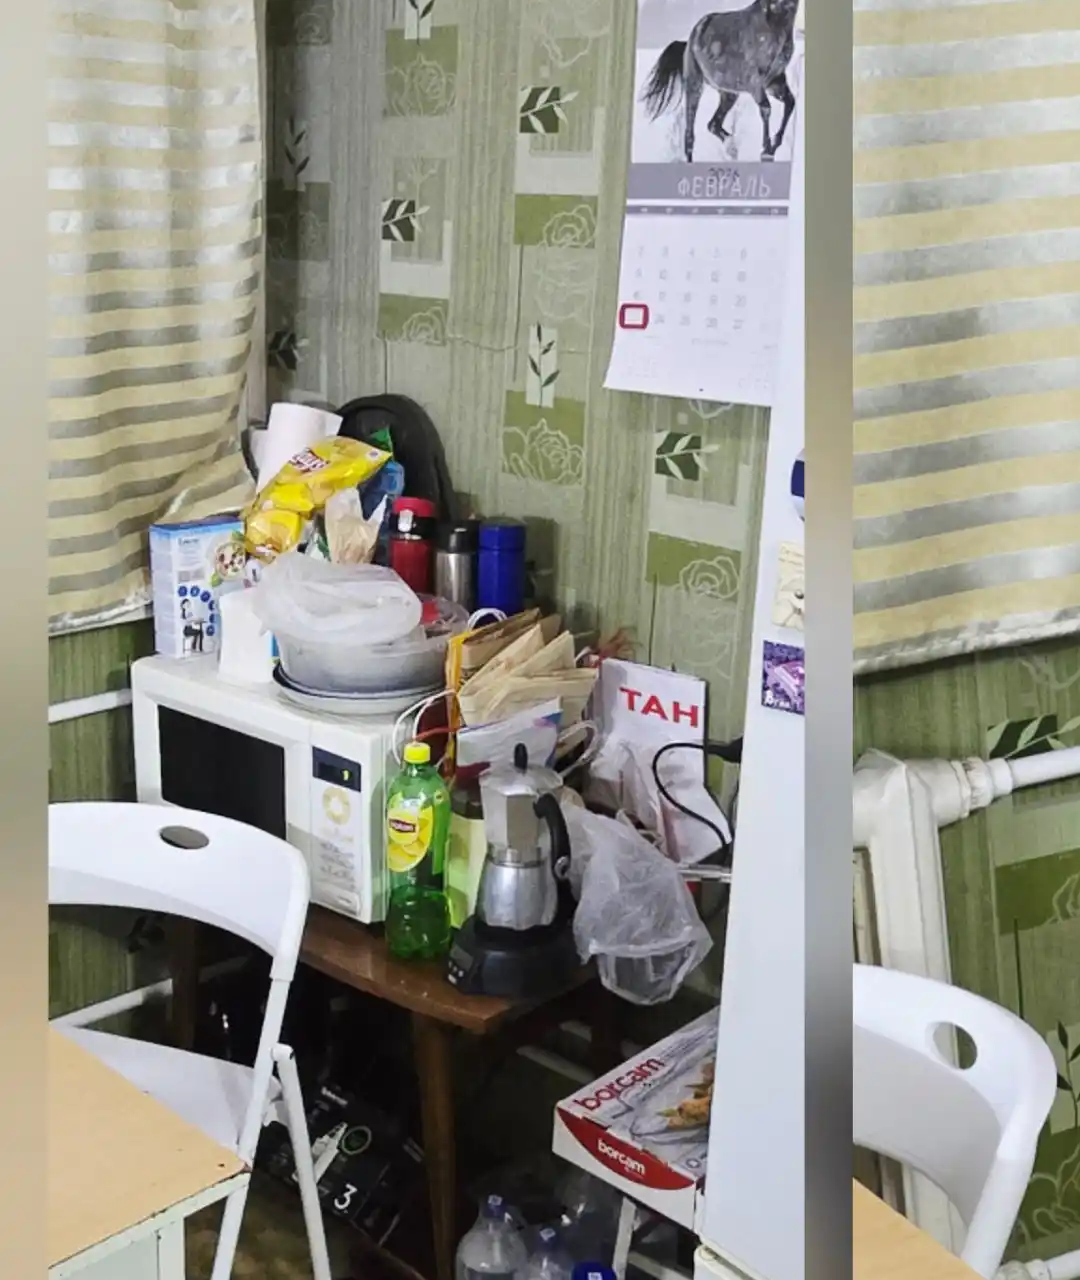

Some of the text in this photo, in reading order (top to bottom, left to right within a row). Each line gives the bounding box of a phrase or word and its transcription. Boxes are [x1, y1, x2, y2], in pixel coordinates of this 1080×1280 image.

[677, 175, 772, 198] ФЕВРАЛЬ
[572, 1058, 666, 1110] borcam
[598, 1140, 646, 1176] borcam
[334, 1183, 358, 1210] 3
